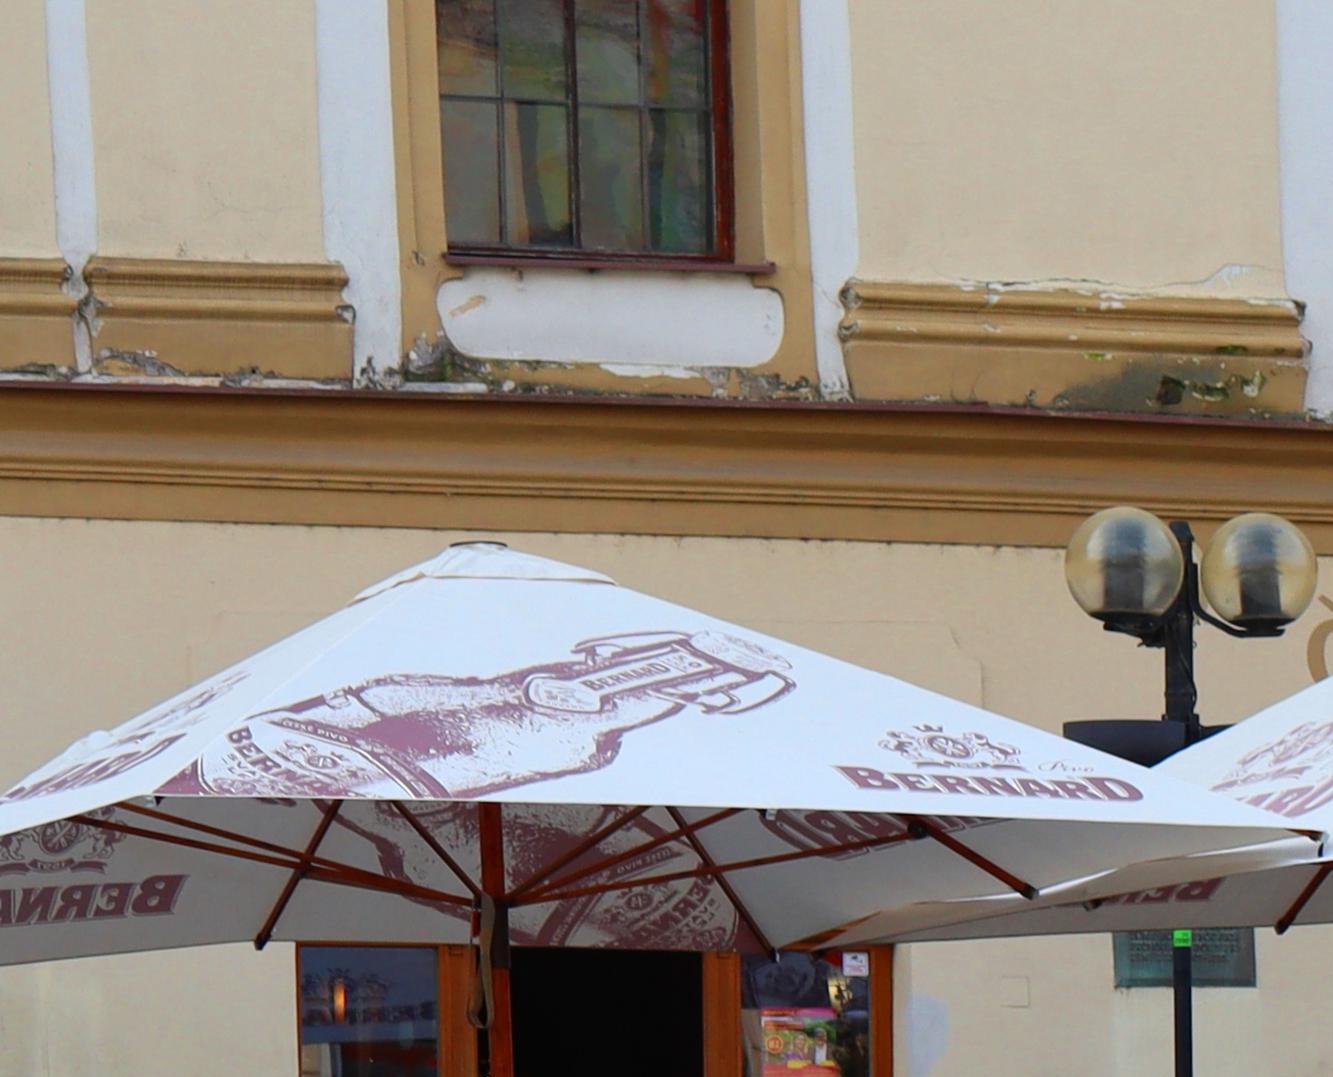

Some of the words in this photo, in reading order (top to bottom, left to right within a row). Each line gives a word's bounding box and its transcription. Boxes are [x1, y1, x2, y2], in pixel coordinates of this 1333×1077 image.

[580, 661, 671, 691] BERNARD
[317, 727, 349, 743] PIVO
[831, 764, 1144, 801] BERNARD
